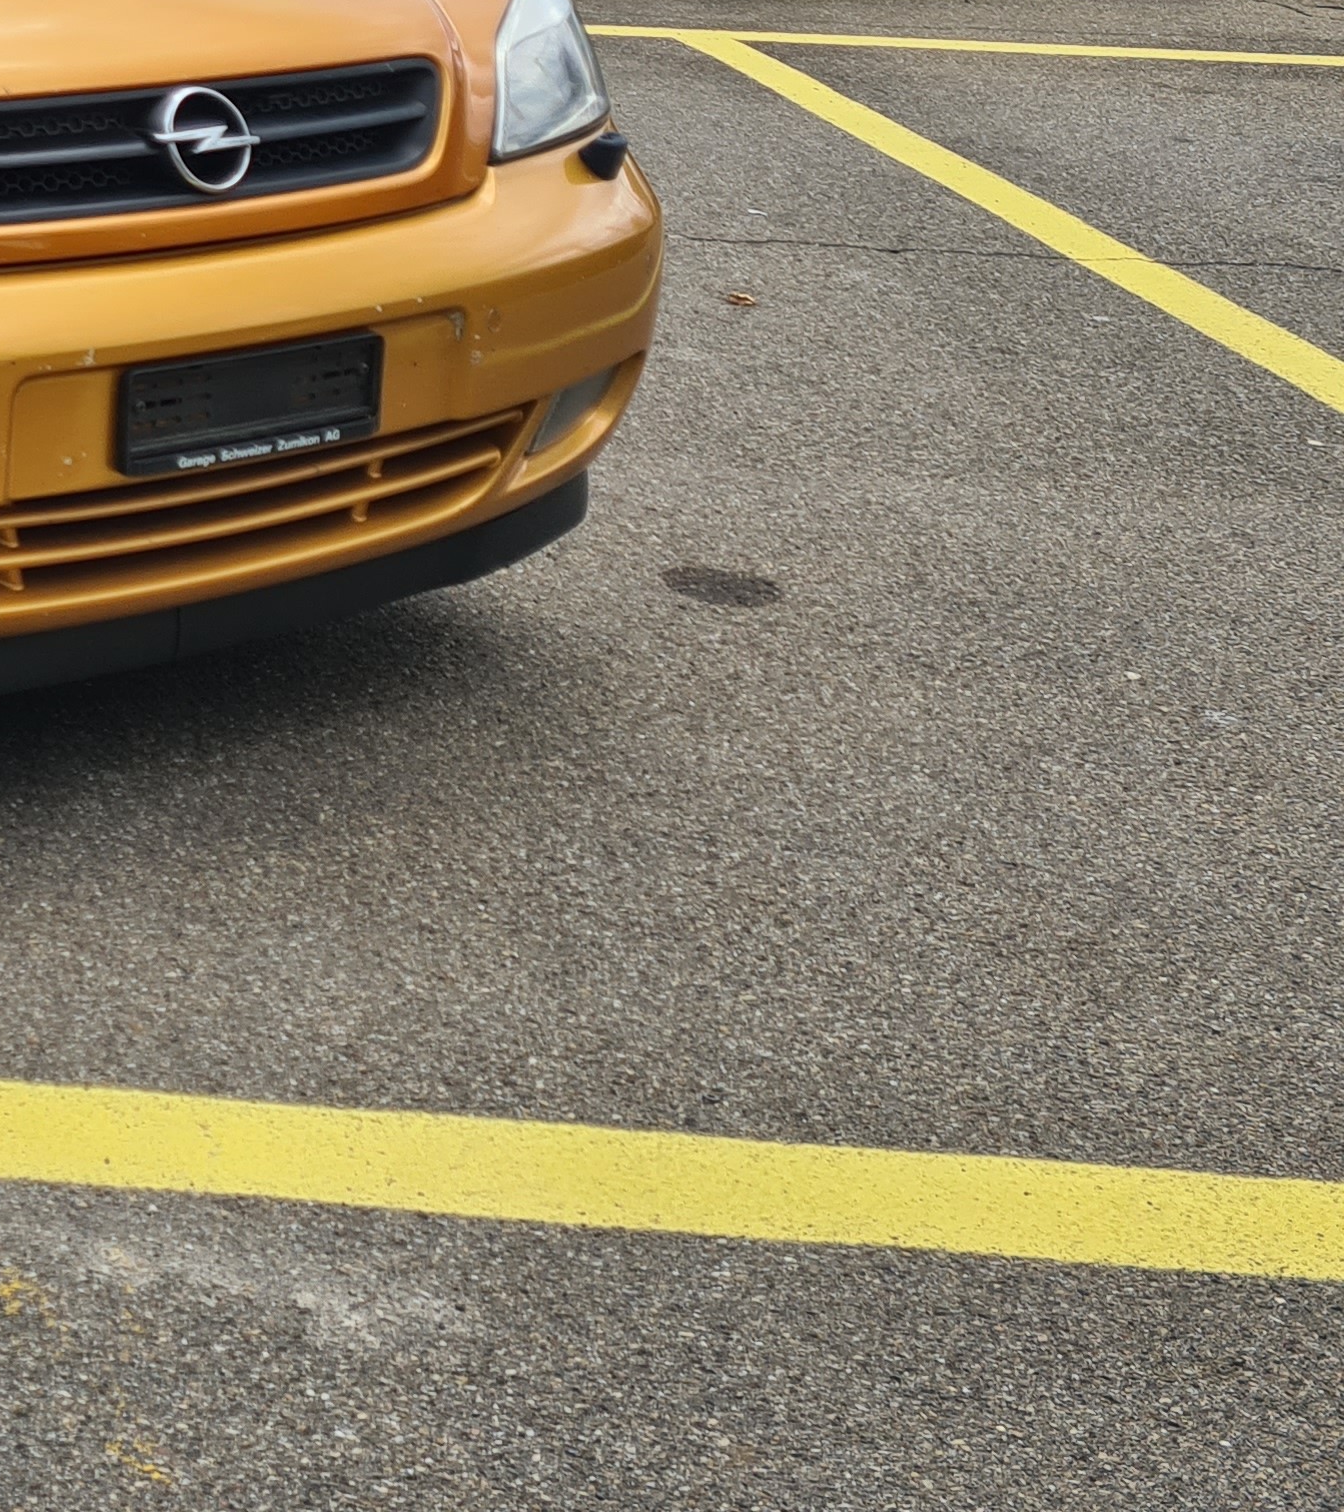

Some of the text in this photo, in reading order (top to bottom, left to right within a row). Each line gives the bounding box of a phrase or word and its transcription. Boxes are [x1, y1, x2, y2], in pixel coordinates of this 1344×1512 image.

[178, 428, 341, 469] Garage Schweizer Zumikon AG
